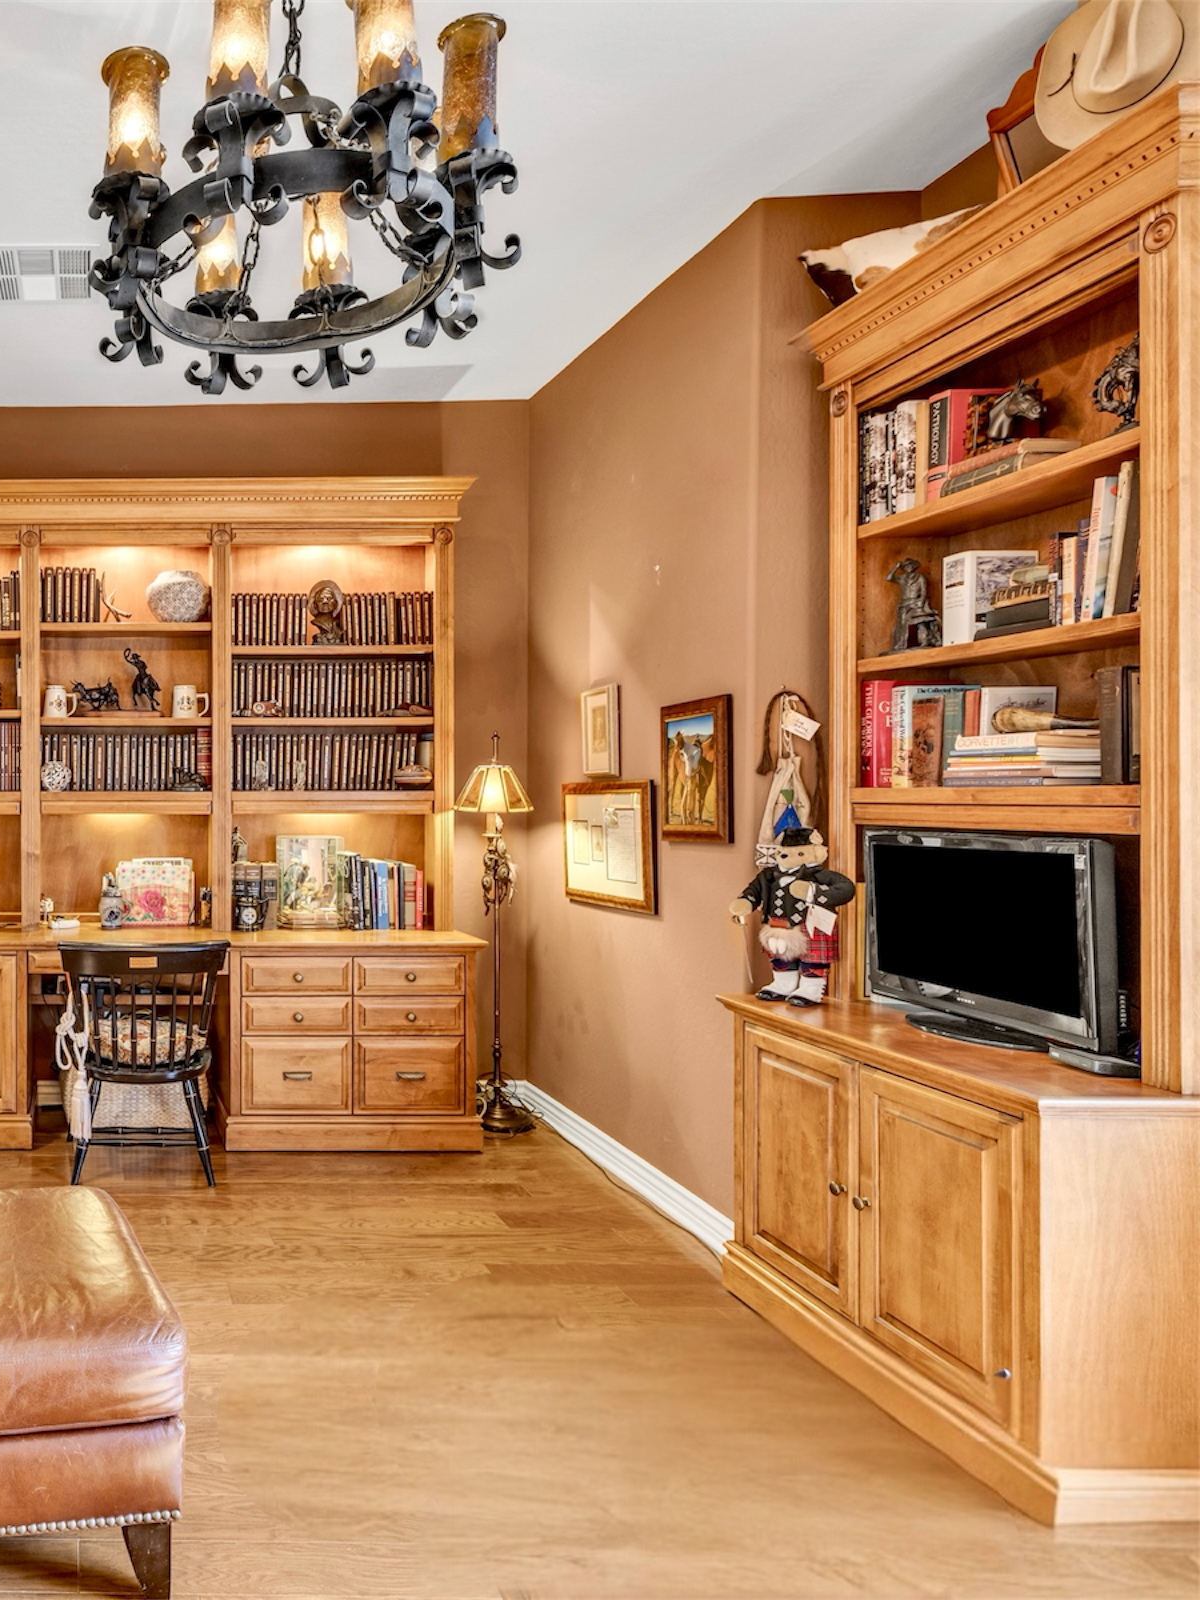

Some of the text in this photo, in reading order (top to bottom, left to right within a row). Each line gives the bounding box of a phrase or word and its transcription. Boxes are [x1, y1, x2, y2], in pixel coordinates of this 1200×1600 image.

[930, 401, 941, 464] PATHOLOGY
[864, 684, 873, 757] THE GLORIOUS
[957, 737, 1007, 748] CORVETTE
